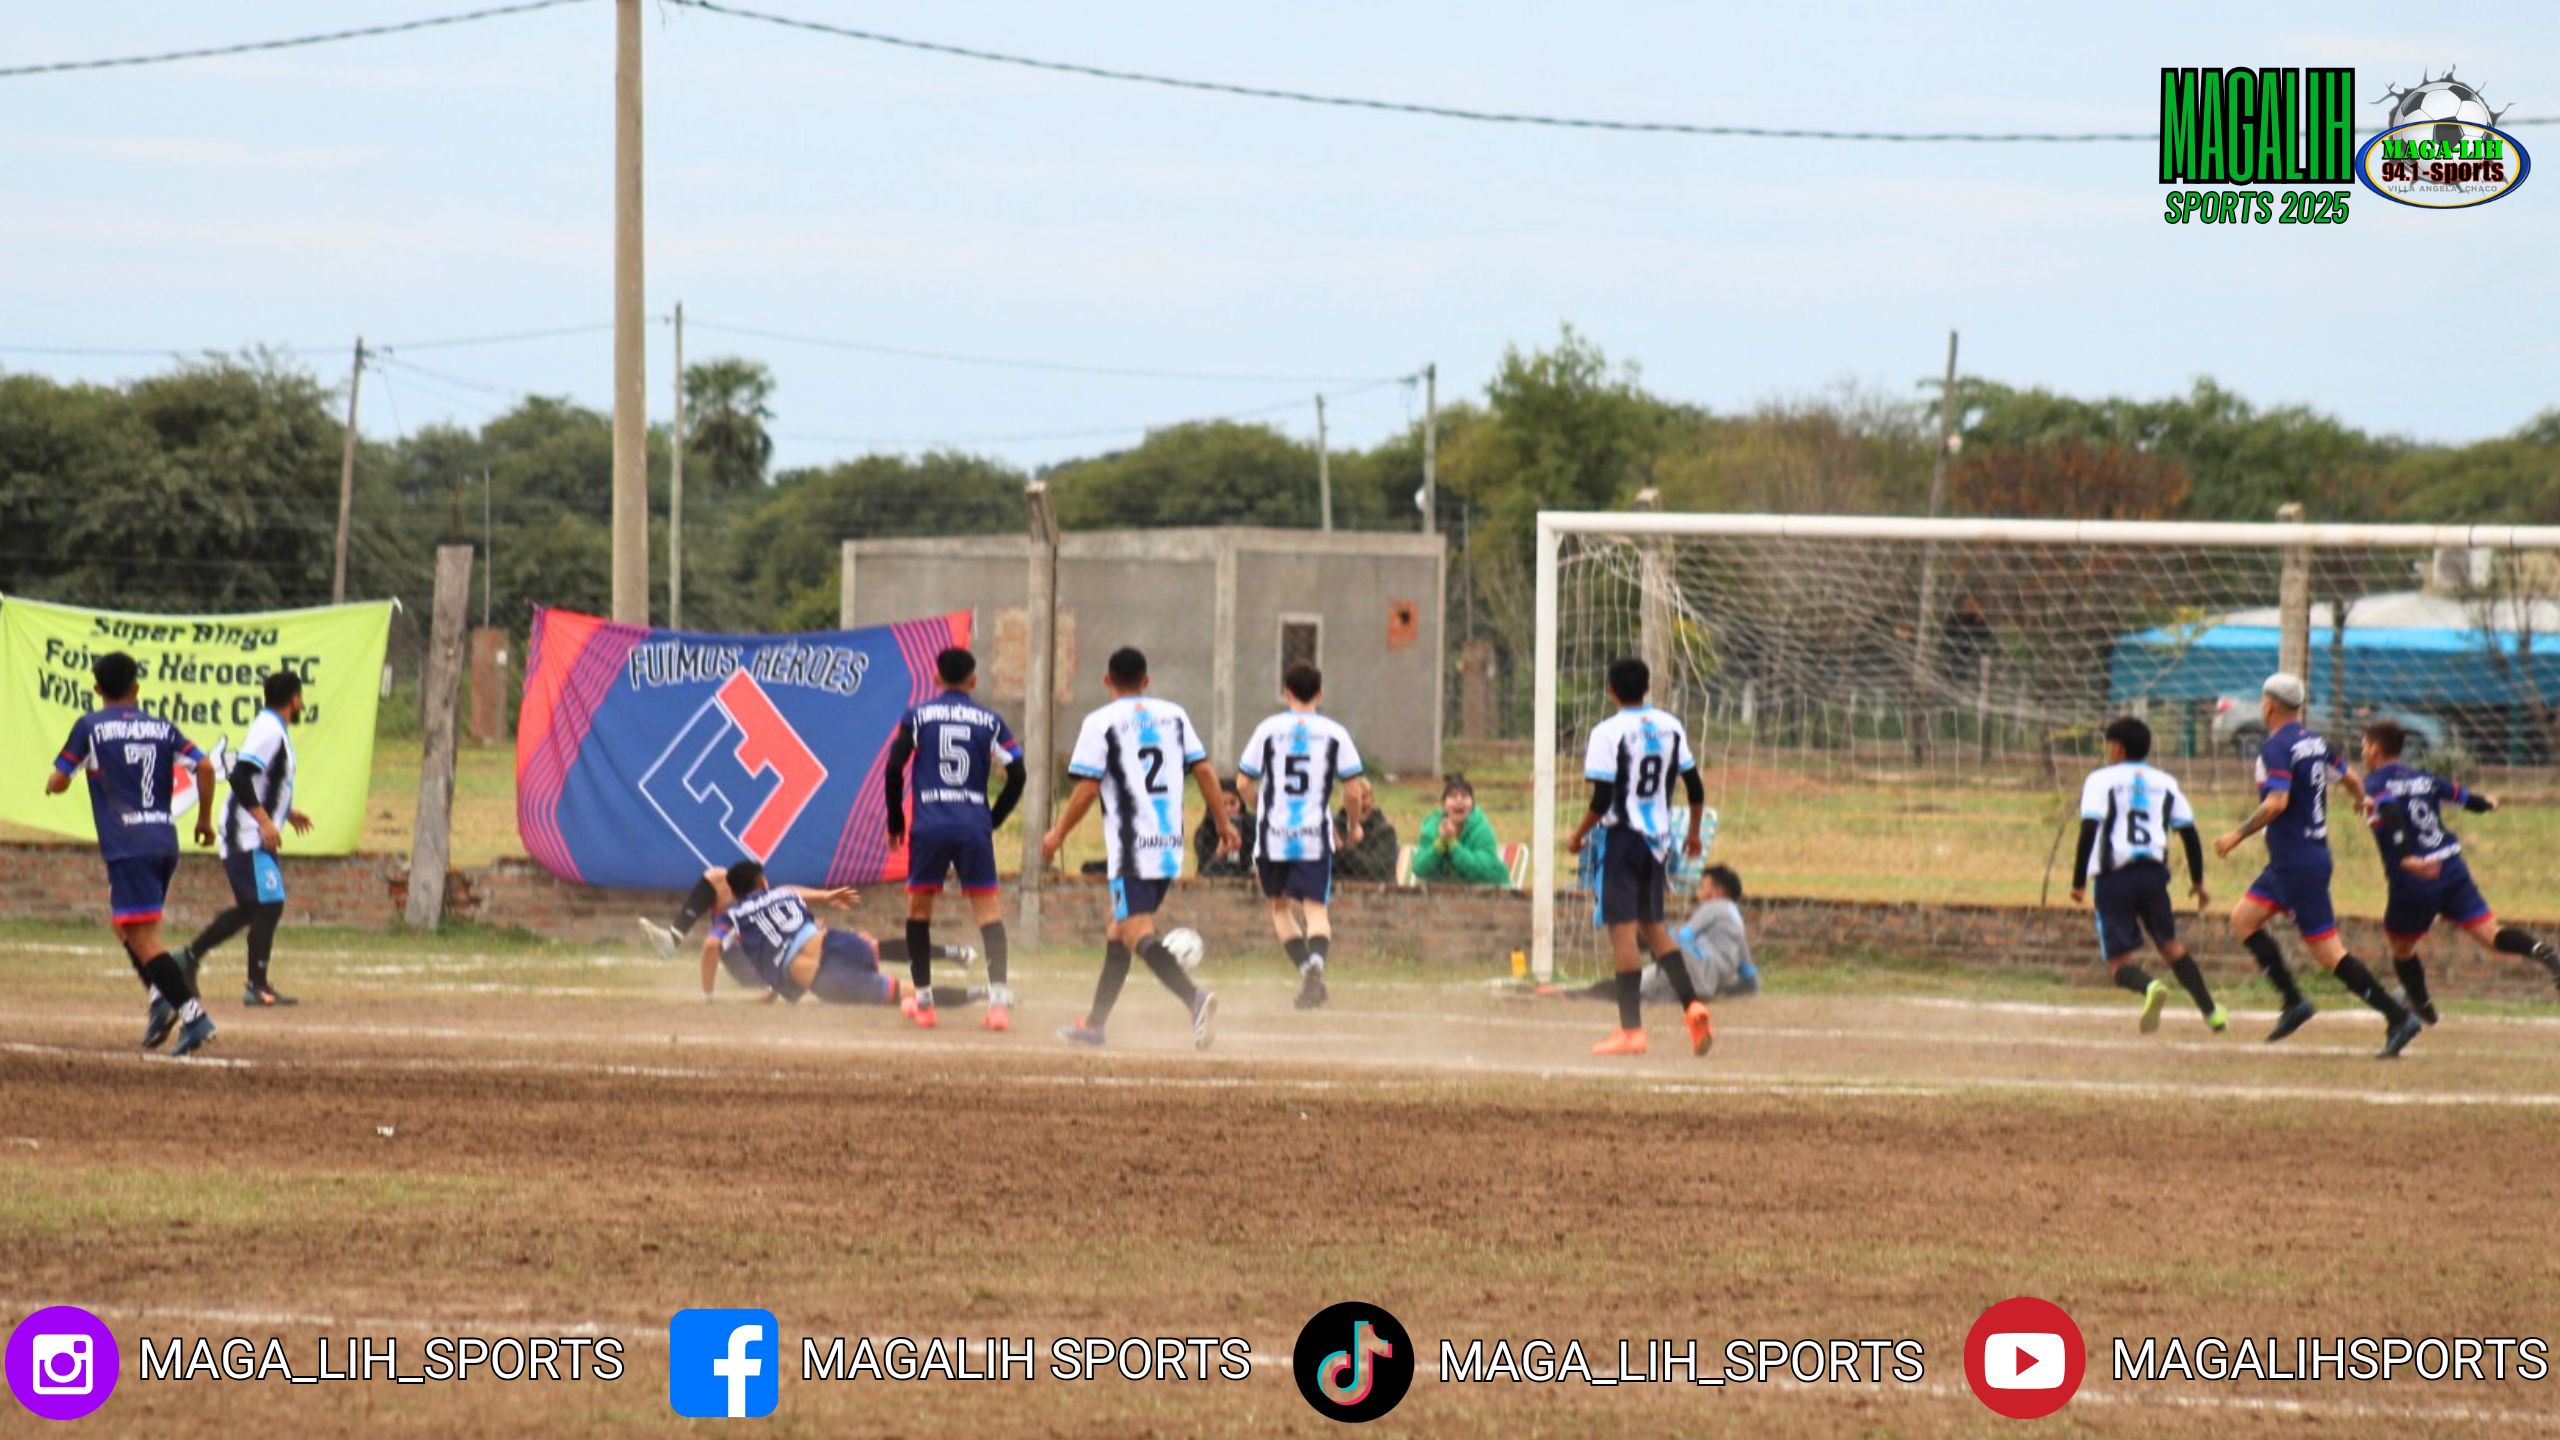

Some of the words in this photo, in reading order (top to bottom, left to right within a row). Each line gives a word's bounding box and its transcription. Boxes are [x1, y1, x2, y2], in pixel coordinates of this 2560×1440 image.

[158, 652, 270, 685] Héroes
[124, 743, 156, 808] 7
[939, 723, 970, 787] 5
[1137, 746, 1168, 795] 2
[1284, 755, 1310, 796] 5
[1636, 755, 1662, 798] 8
[2127, 809, 2151, 846] 6
[2408, 799, 2445, 849] 9
[748, 898, 805, 949] 10
